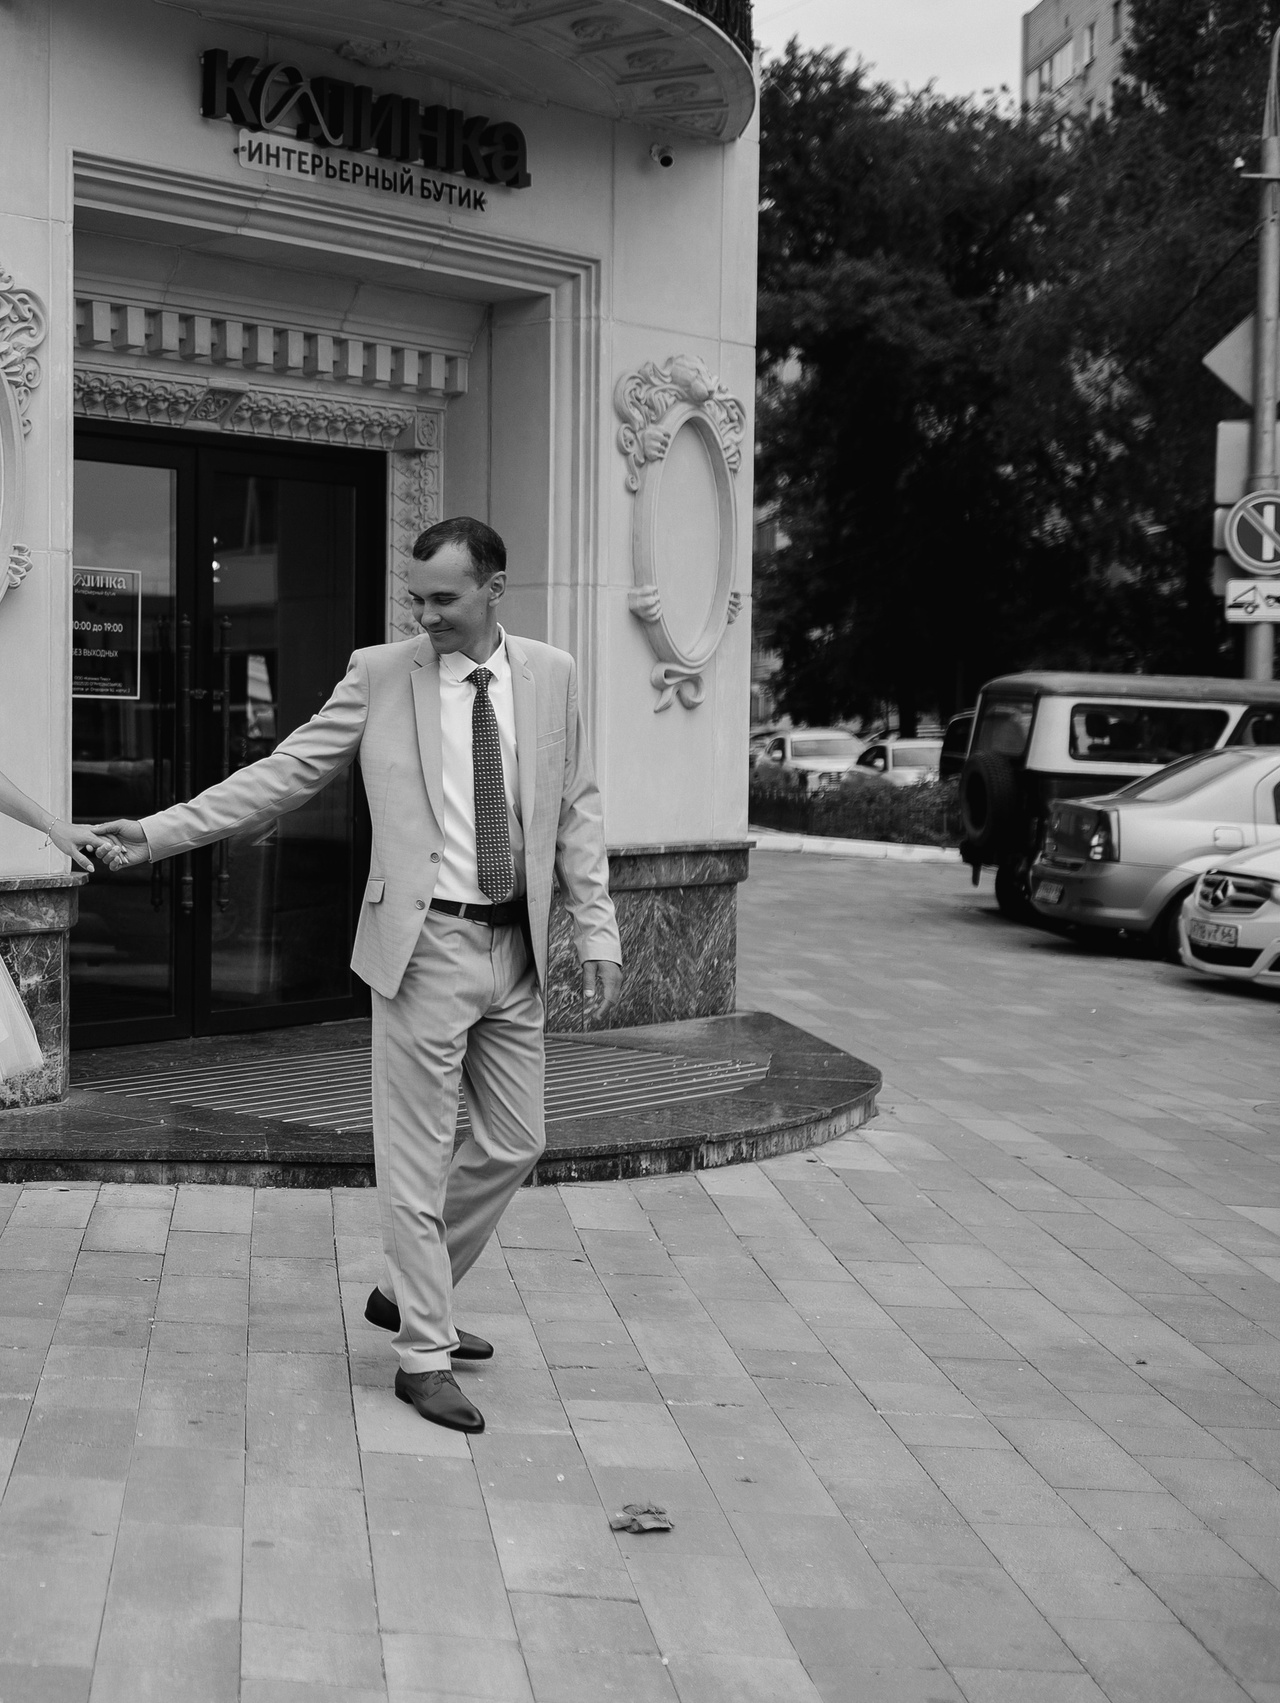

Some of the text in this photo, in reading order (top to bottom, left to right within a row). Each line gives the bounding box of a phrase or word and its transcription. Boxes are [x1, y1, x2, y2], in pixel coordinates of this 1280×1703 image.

[247, 139, 486, 212] ИНТЕРЬЕРНЫЙ БУТИК
[72, 620, 123, 633] 0:00 до 19:00
[82, 648, 119, 658] ВЫХОДНЫХ
